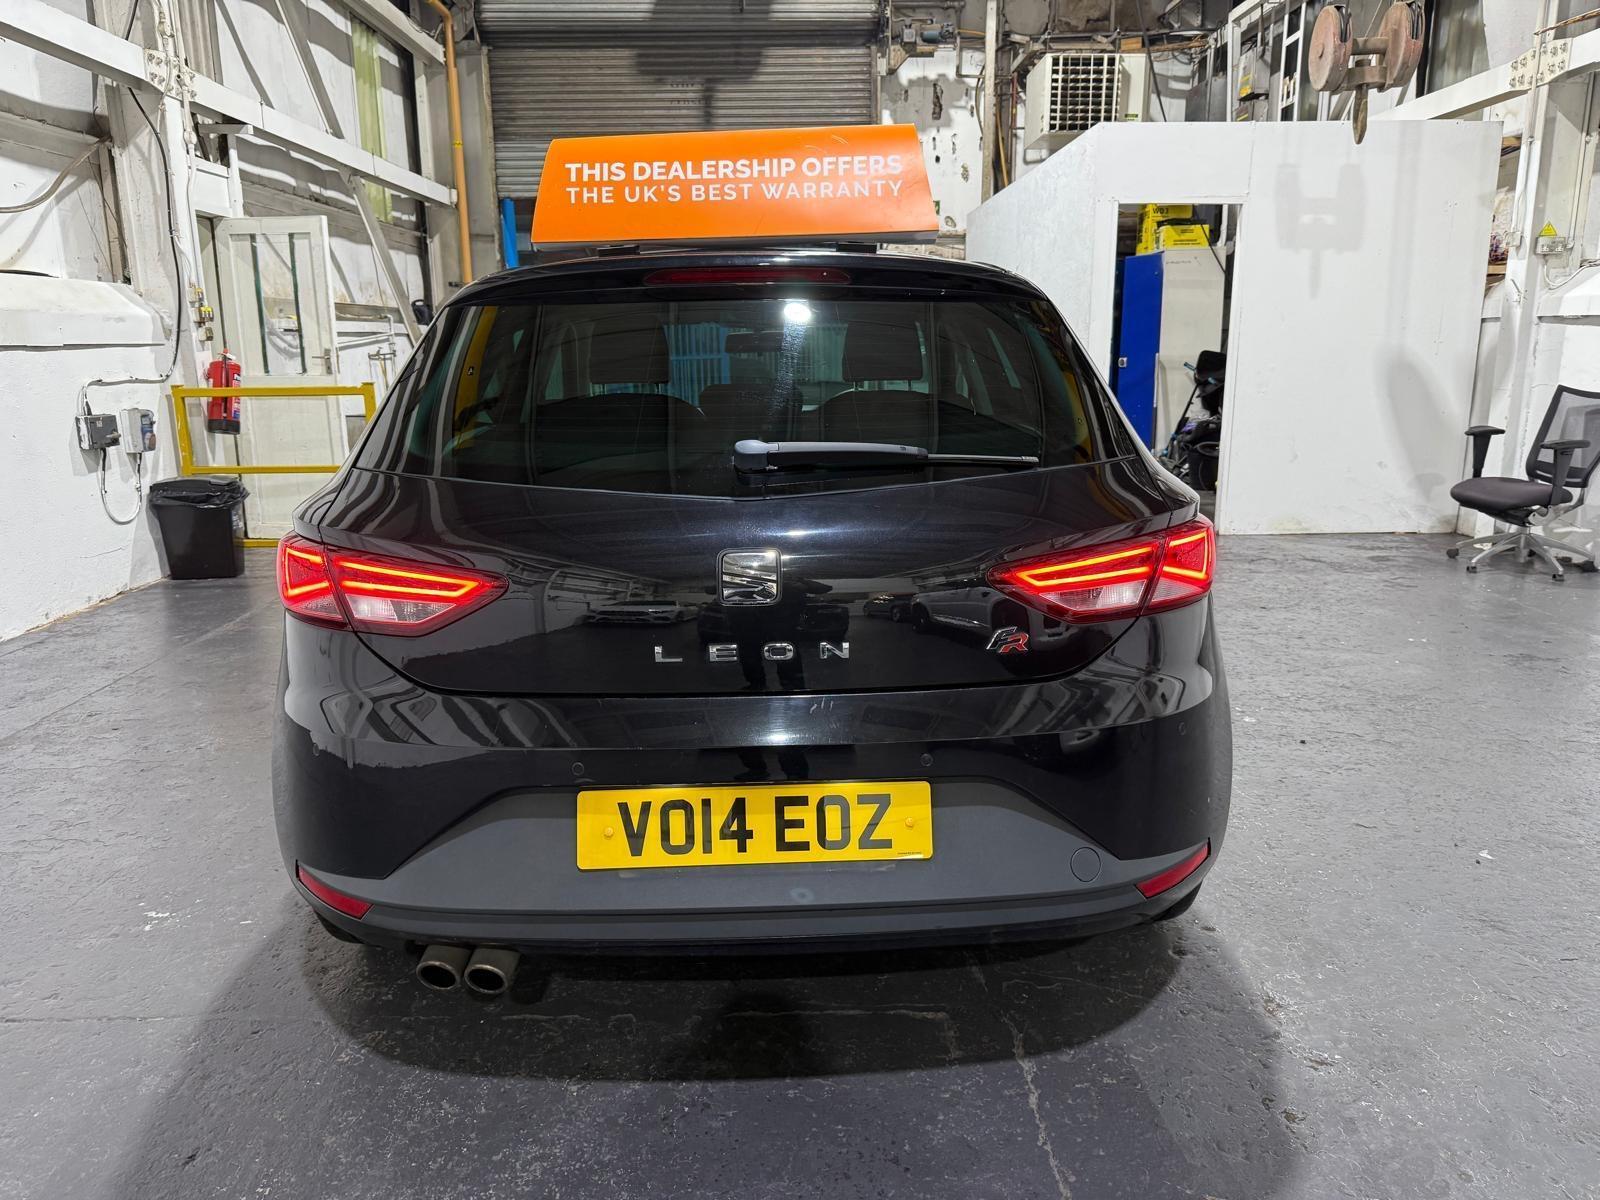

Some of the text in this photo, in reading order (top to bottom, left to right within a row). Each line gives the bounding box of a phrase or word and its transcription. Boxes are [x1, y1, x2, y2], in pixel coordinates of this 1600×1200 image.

[565, 155, 903, 182] THIS DEALERSHIP OFFERS
[566, 179, 903, 204] THE UK'S BEST WARRANTY
[654, 642, 850, 662] LEON
[986, 626, 1029, 653] FR
[617, 793, 893, 857] VO14 EOZ
